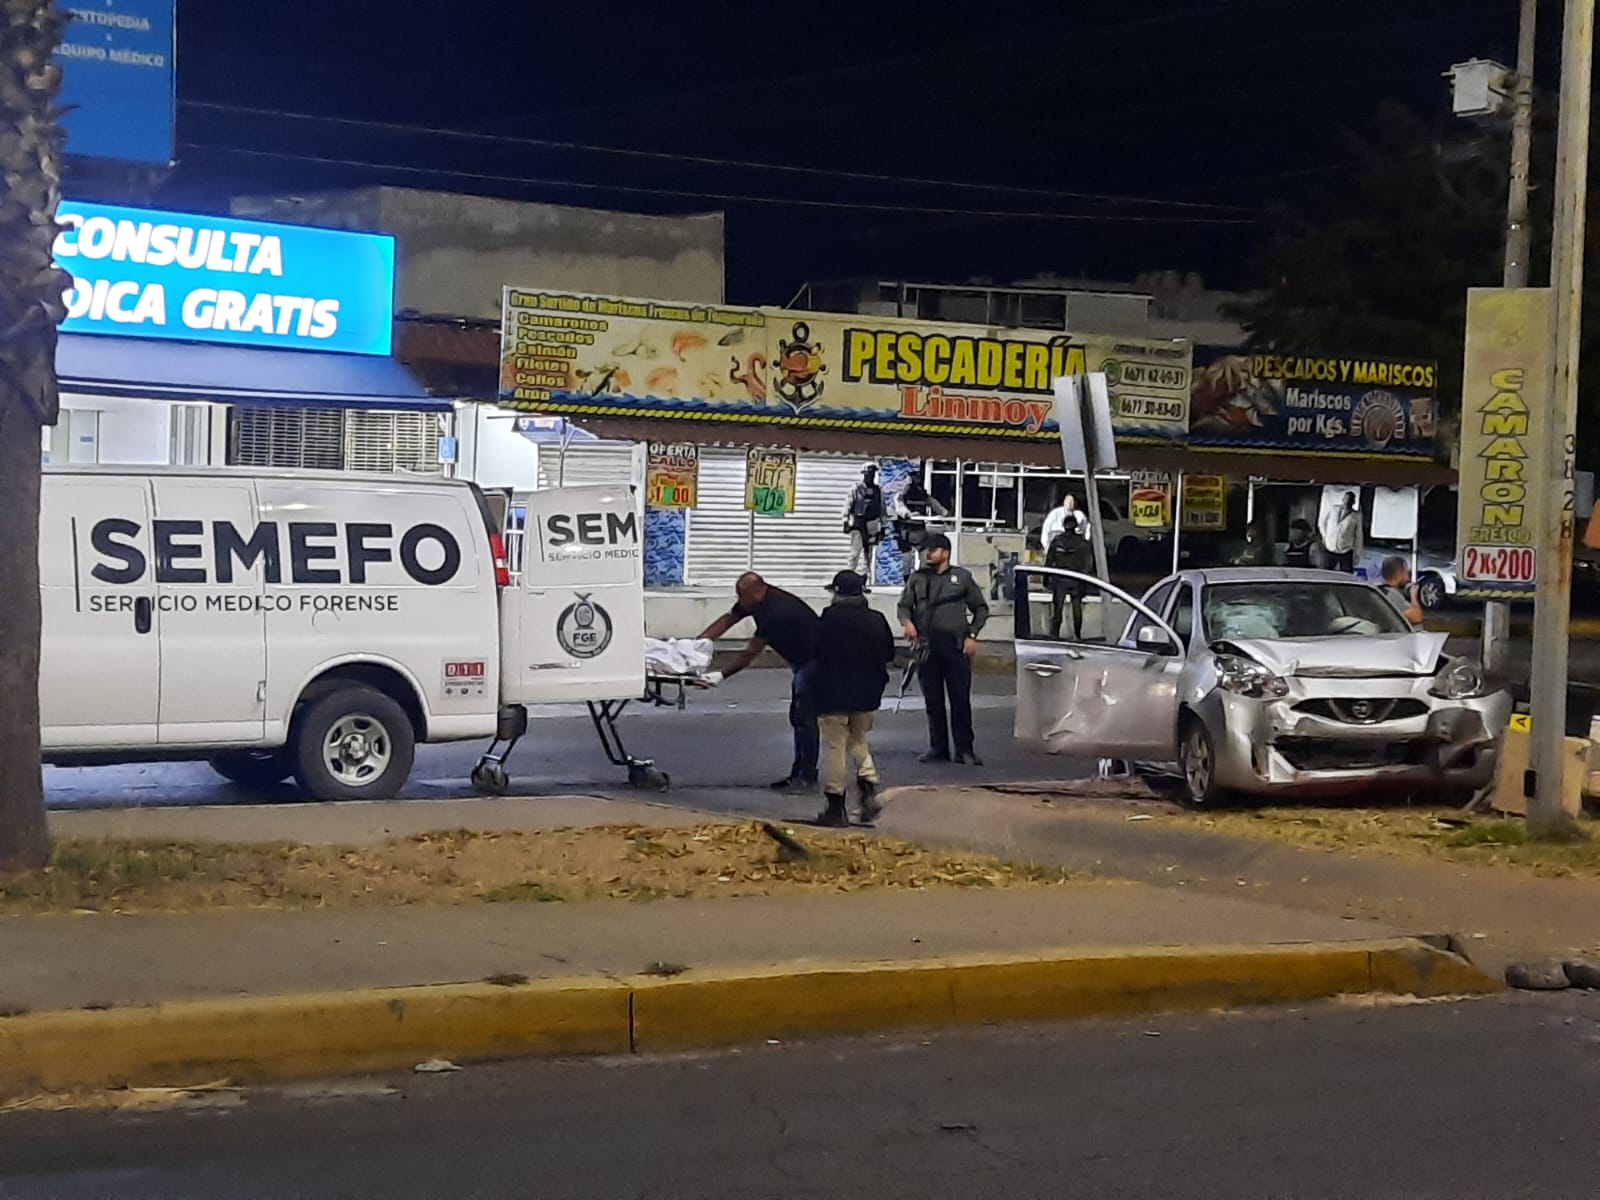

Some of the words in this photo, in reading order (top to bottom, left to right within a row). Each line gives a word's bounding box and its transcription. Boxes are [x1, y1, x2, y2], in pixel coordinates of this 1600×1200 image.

[53, 214, 282, 275] CONSULTA
[182, 288, 339, 338] GRATIS
[519, 313, 608, 331] Camarones
[844, 331, 1086, 392] PESCADERÍA
[1253, 355, 1337, 381] PESCADOS
[1340, 360, 1352, 381] Y
[1354, 361, 1435, 388] MARISCOS
[900, 384, 1051, 434] Linmoy
[1286, 387, 1351, 411] Mariscos
[1288, 418, 1312, 436] por
[649, 444, 696, 457] OFERTA
[547, 512, 638, 546] SEM
[1471, 527, 1532, 544] FRESCO
[91, 518, 461, 585] SEMEFO
[90, 594, 197, 612] SERICIO
[205, 595, 292, 611] MEDICO
[300, 595, 399, 611] FORENSE
[573, 632, 597, 643] FGE
